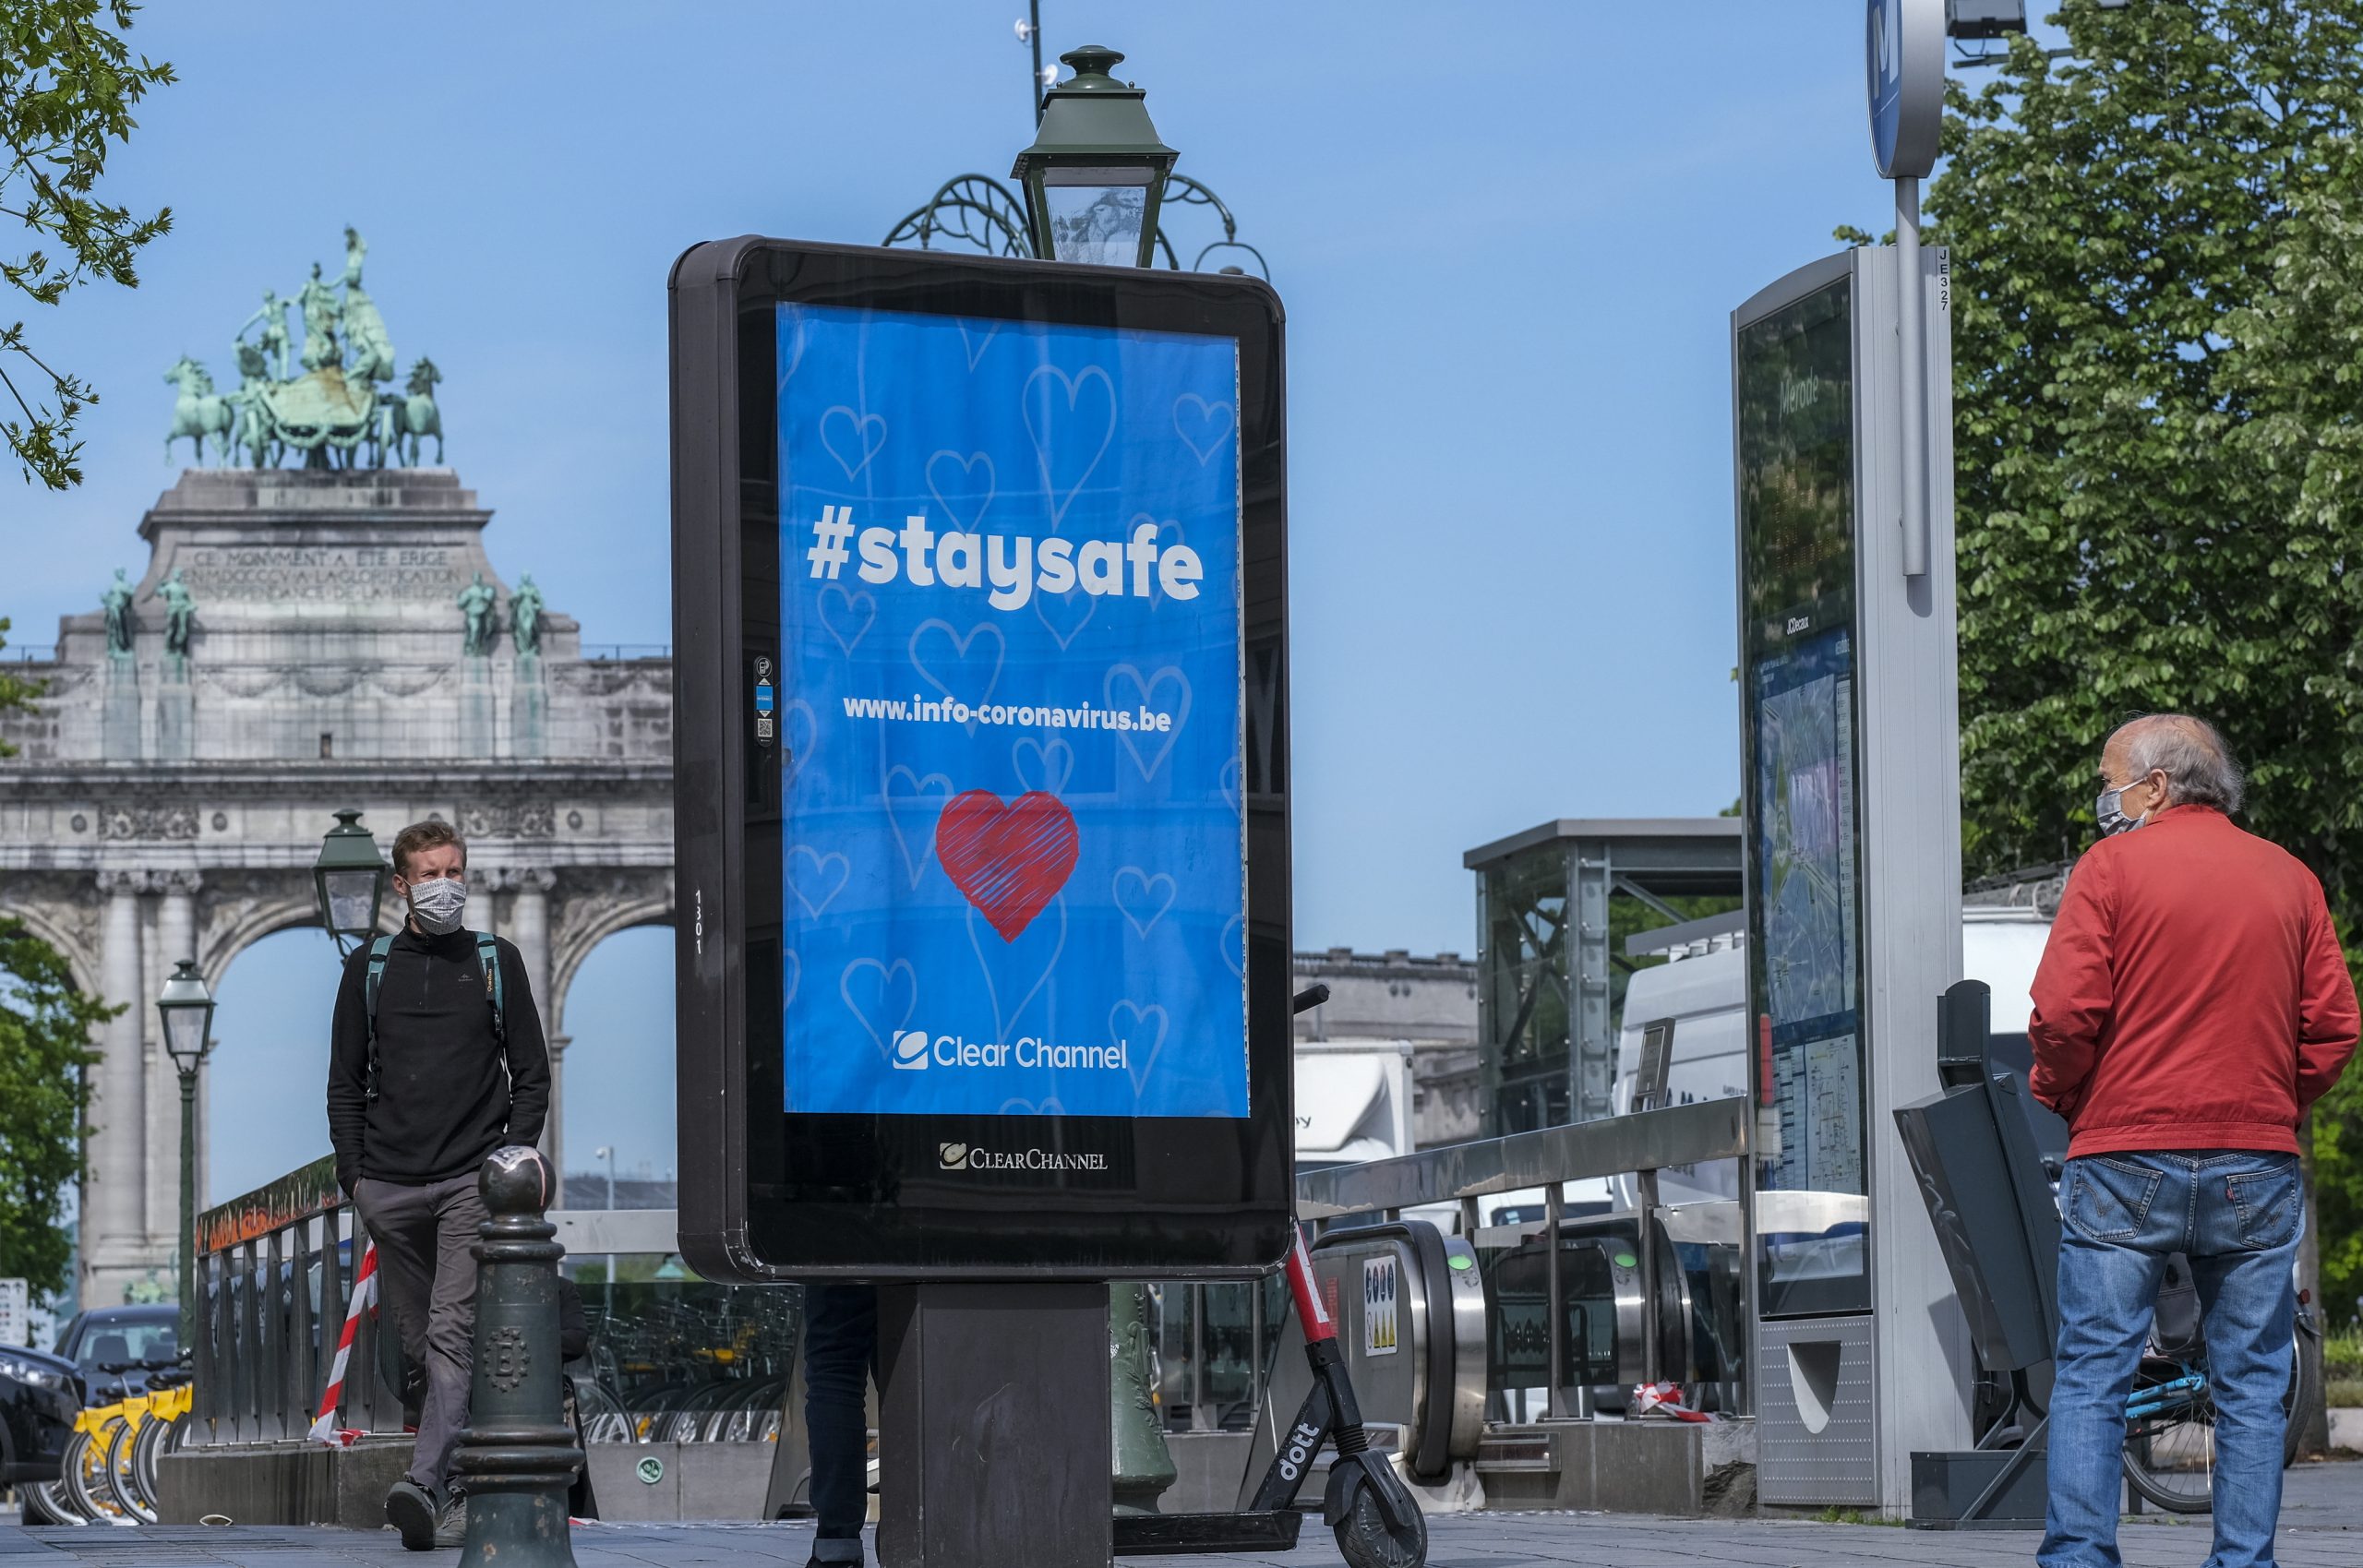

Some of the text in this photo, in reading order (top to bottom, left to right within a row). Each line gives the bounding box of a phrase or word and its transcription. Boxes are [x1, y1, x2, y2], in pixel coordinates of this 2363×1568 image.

[1873, 0, 1898, 100] M
[807, 505, 1204, 612] #staysafe
[1786, 616, 1809, 636] JCDecaux
[843, 694, 1172, 732] www.info-coronavirus.be
[933, 1035, 1127, 1069] Clear Channel
[1279, 1422, 1320, 1481] dott
